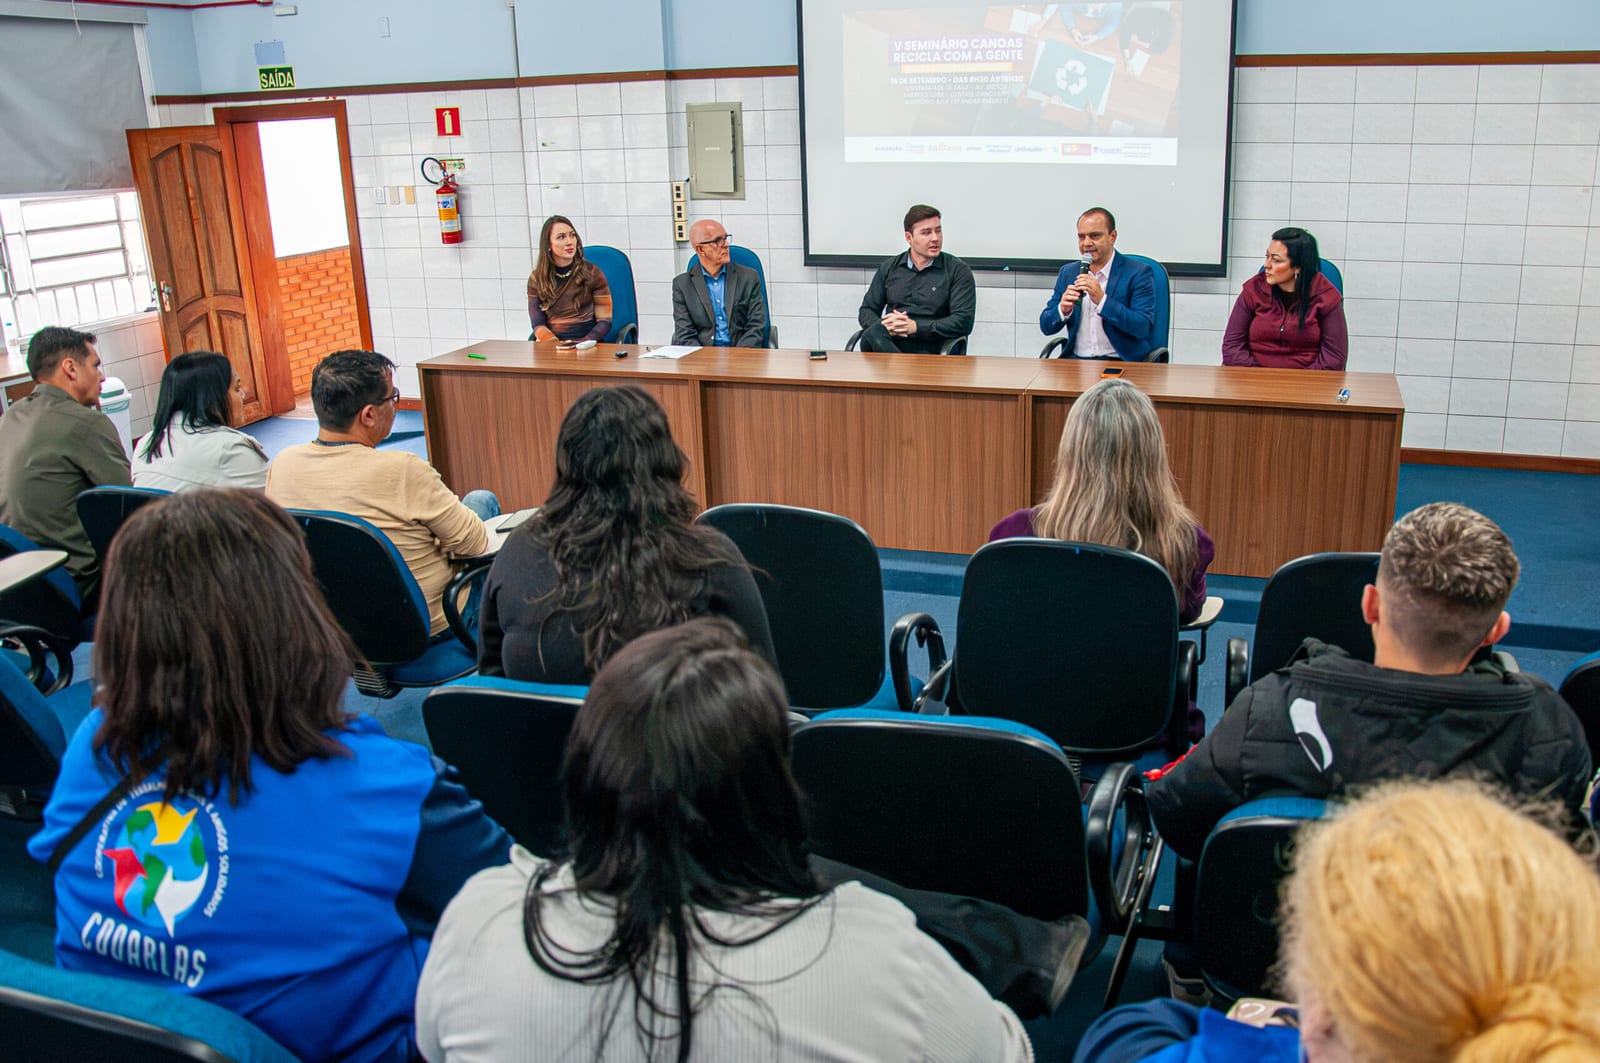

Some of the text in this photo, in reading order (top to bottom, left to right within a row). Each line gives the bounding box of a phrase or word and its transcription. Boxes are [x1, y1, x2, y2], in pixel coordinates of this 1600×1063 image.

[893, 36, 1024, 51] V SEMINÁRIO CANOAS
[893, 49, 1024, 63] RECICLA COM A GENTE
[260, 68, 294, 88] SAÍDA
[909, 76, 947, 84] SETEMBRO
[81, 911, 207, 989] COOARLAS
